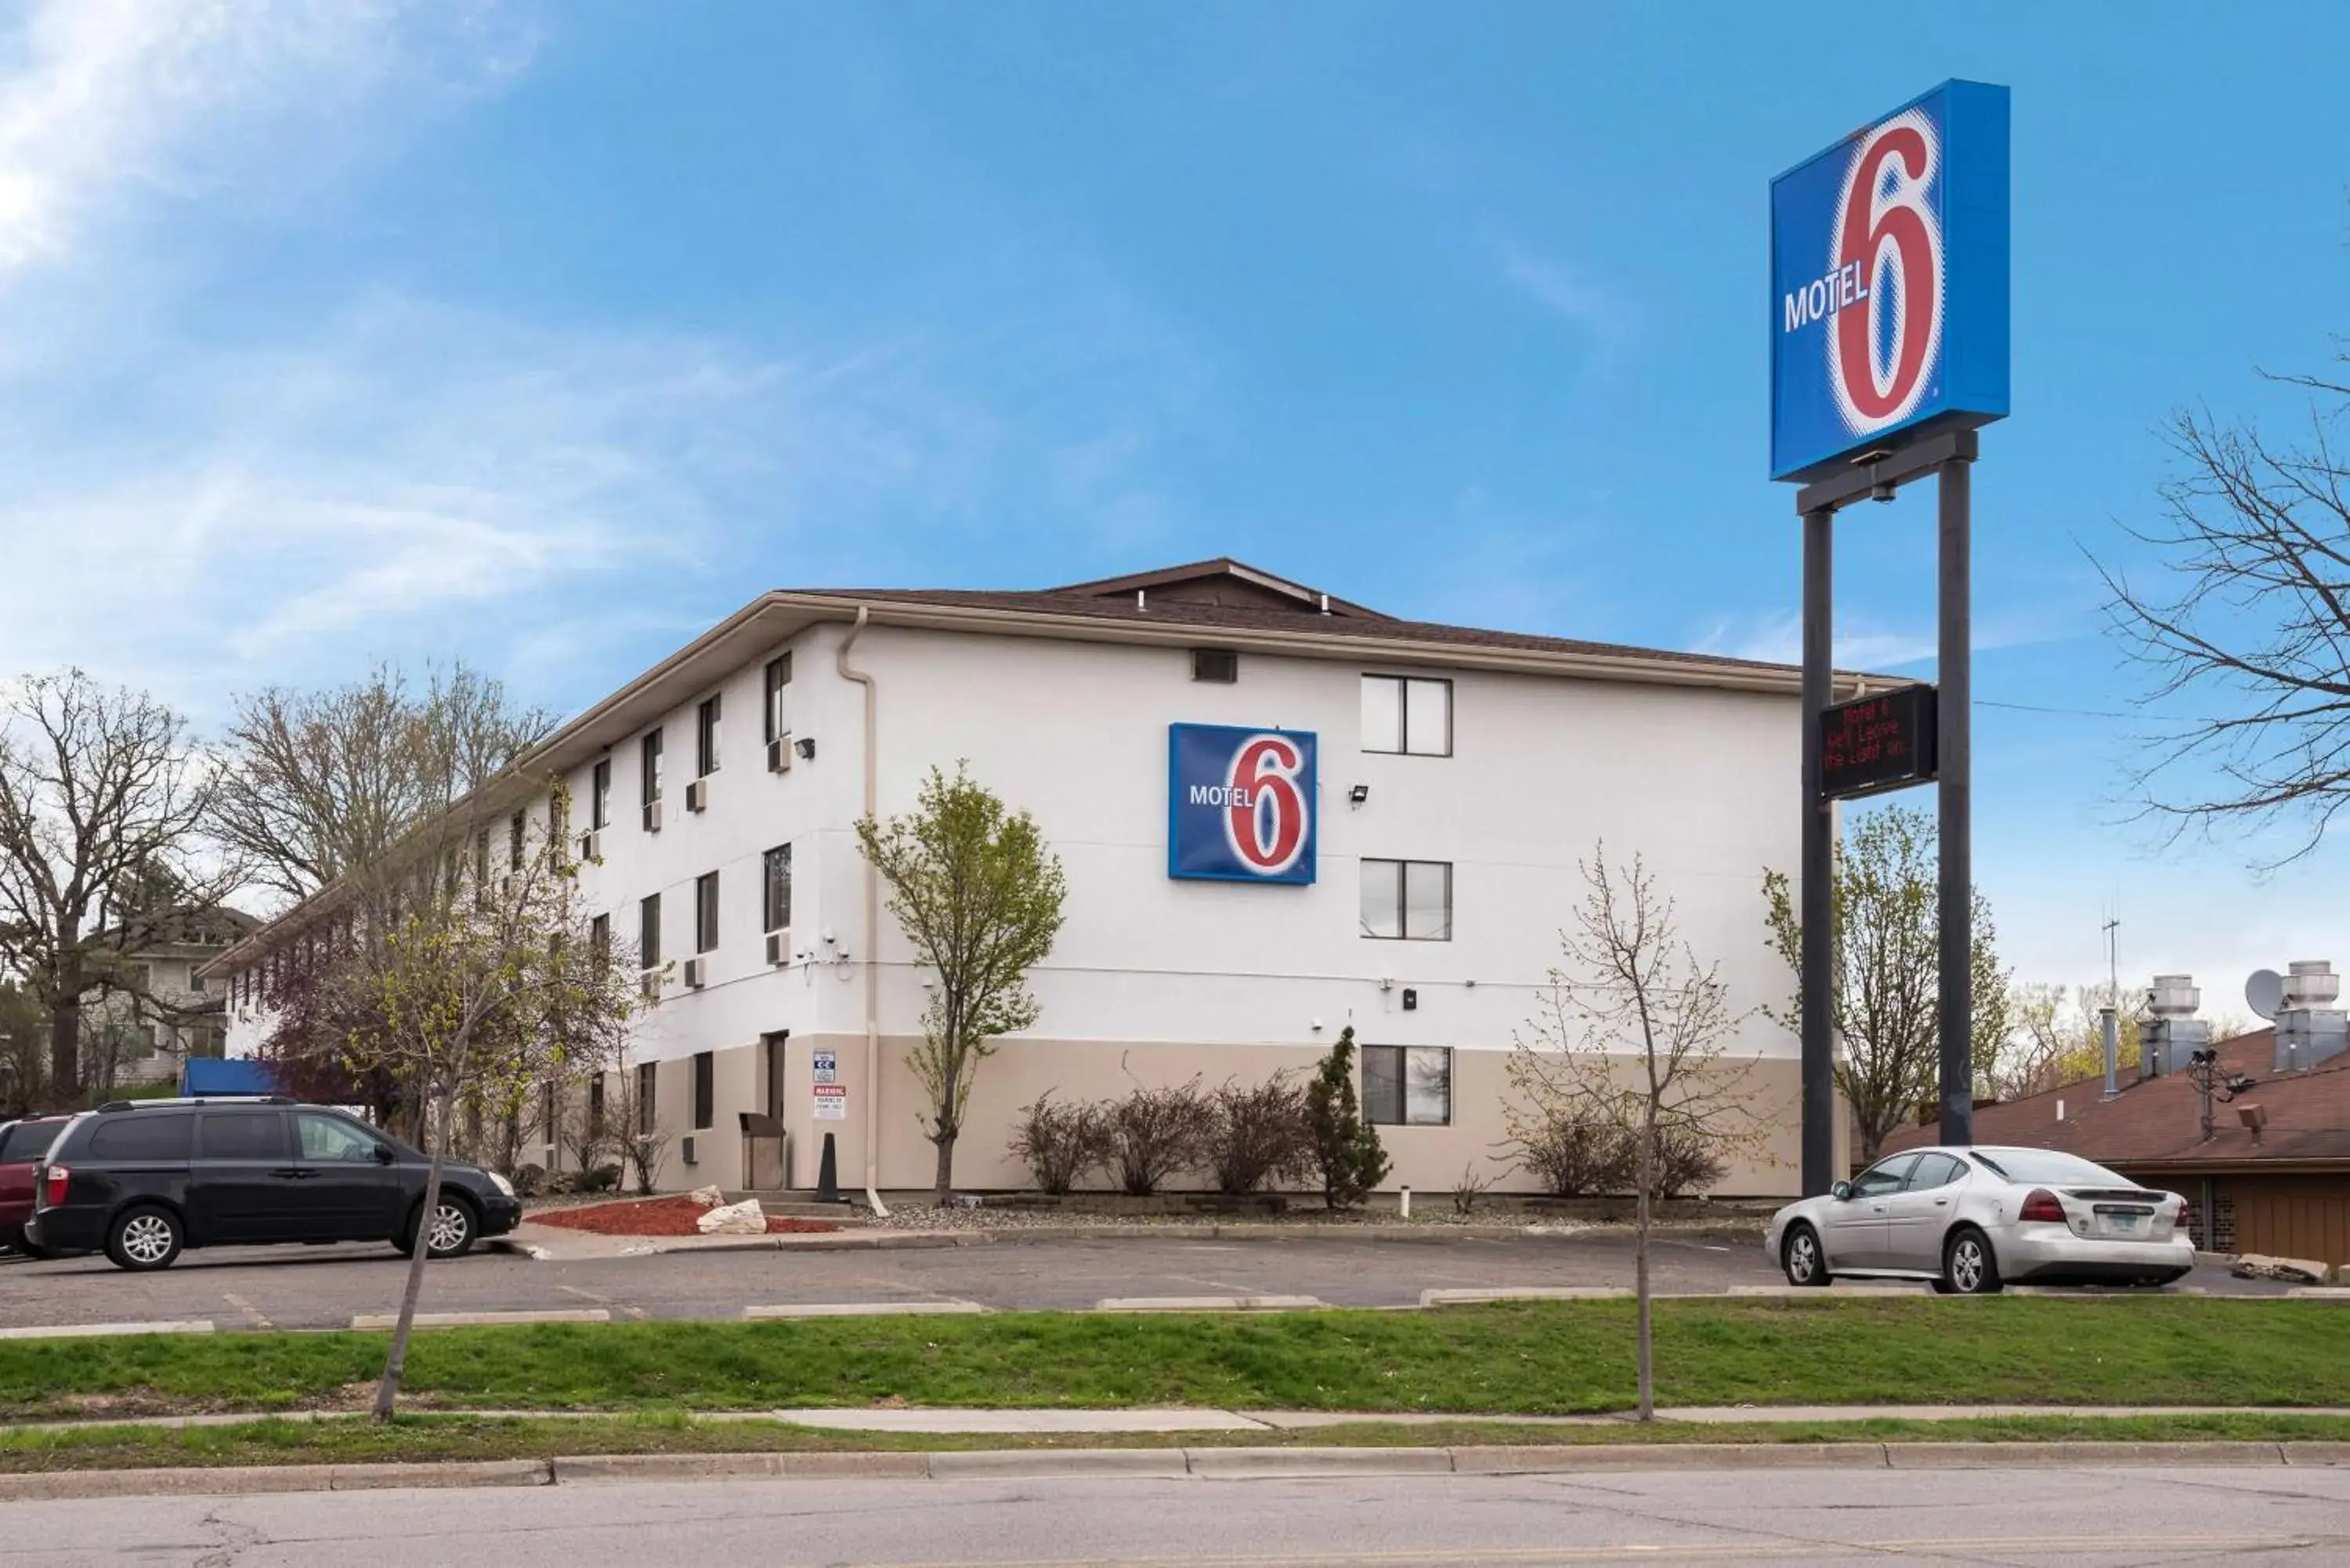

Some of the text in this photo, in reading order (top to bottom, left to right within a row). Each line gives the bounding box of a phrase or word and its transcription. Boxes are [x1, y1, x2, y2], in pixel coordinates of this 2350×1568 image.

[1784, 124, 1936, 421] MOTEL 6
[1190, 739, 1302, 868] MOTEL 6
